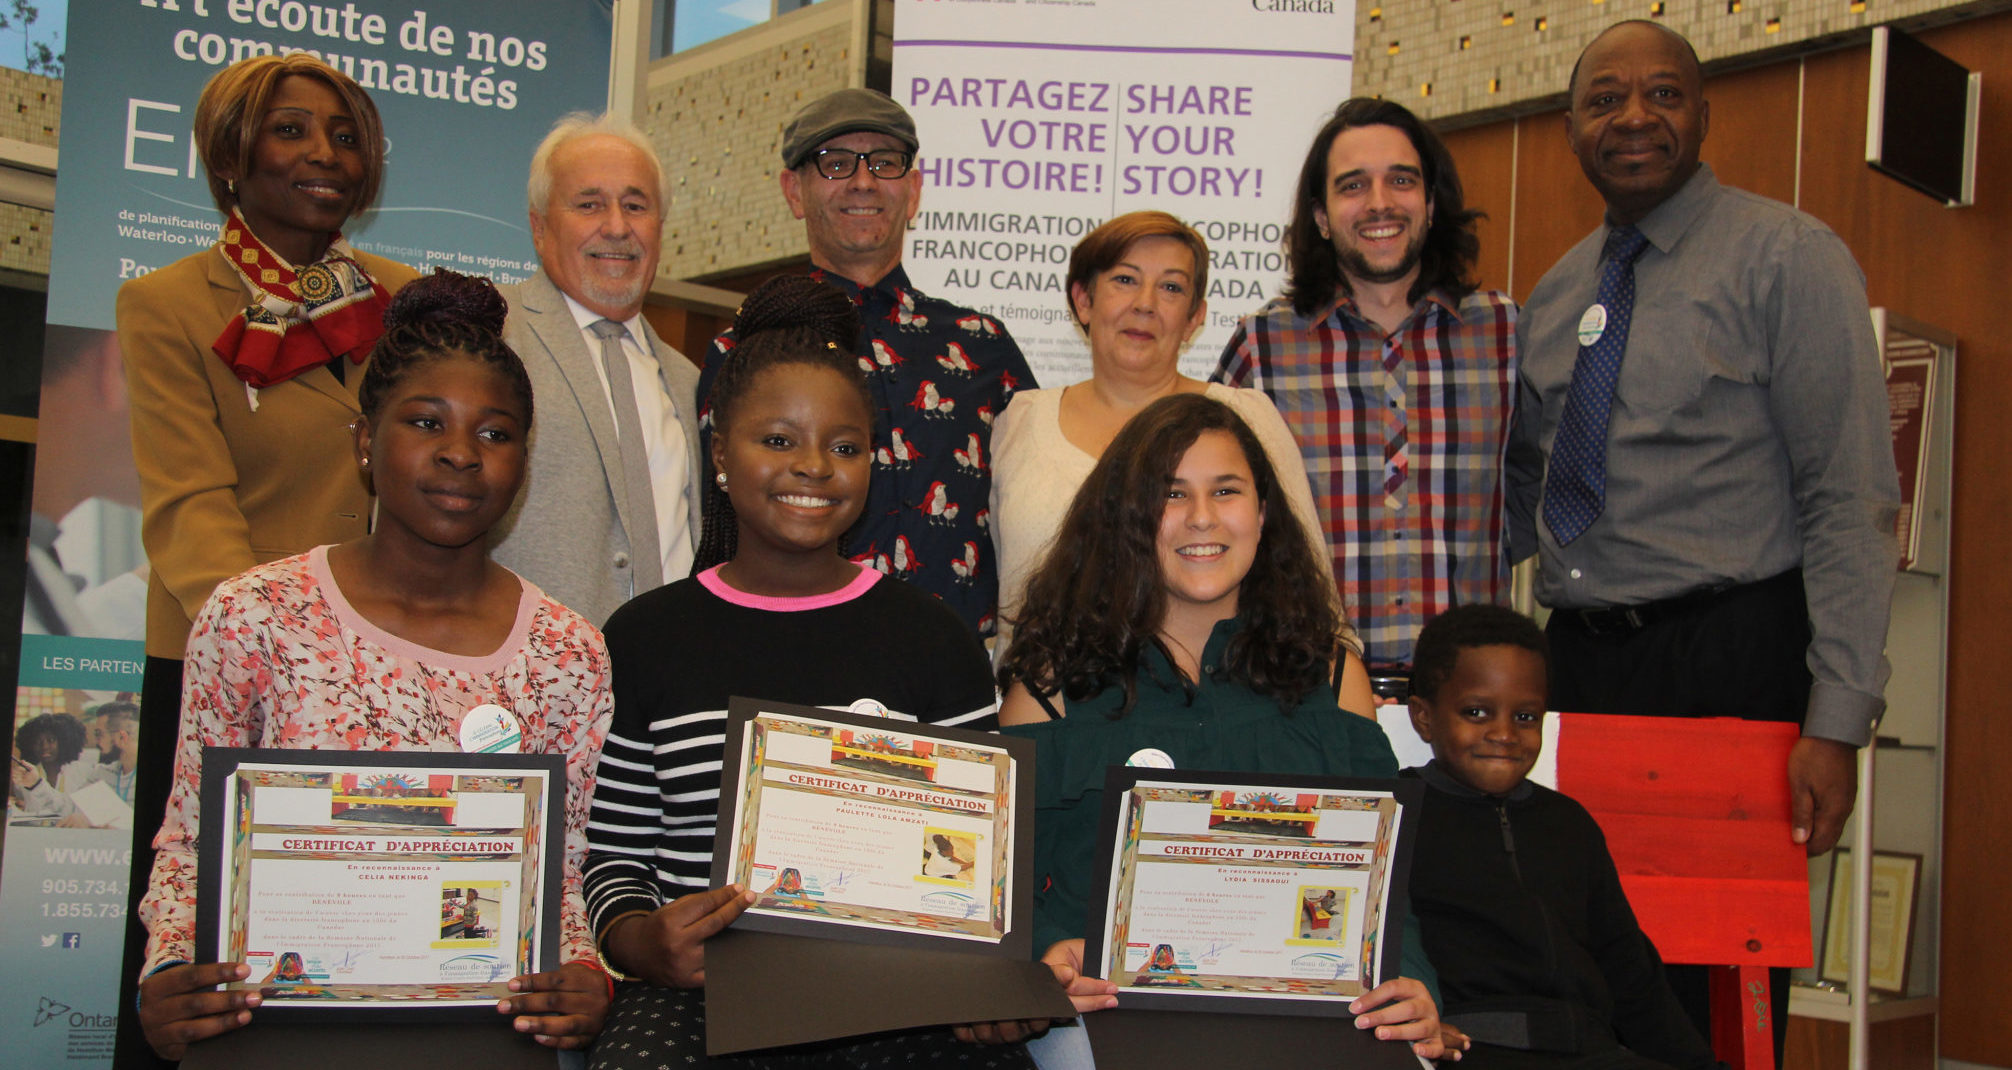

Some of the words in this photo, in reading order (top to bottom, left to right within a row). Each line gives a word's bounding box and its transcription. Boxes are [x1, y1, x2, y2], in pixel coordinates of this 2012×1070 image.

[399, 11, 454, 56] de
[467, 31, 547, 71] nos
[910, 77, 1109, 113] PARTAGEZ
[1126, 84, 1253, 116] SHARE
[981, 119, 1107, 153] VOTRE
[1125, 125, 1235, 156] YOUR
[919, 157, 1103, 194] HISTOIRE!
[1123, 165, 1263, 198] STORY!
[118, 209, 135, 221] de
[138, 213, 220, 233] planification
[118, 224, 186, 244] Waterloo
[426, 250, 455, 263] pour
[458, 252, 474, 264] les
[477, 255, 521, 269] régions
[523, 261, 538, 273] de
[912, 240, 1076, 264] FRANCOPHO
[944, 269, 980, 288] AU
[990, 270, 1069, 292] CANA
[43, 657, 75, 671] LES
[80, 658, 144, 674] PARTEN
[789, 774, 867, 793] CERTIFICAT
[877, 786, 986, 811] D'APPRÉCIATION
[836, 807, 875, 818] PAULETTE
[283, 839, 376, 851] CERTIFICAT
[387, 839, 514, 852] D'APPRÉCIATION
[1164, 845, 1244, 857] CERTIFICAT
[1253, 849, 1365, 862] D'APPRÉCIATION
